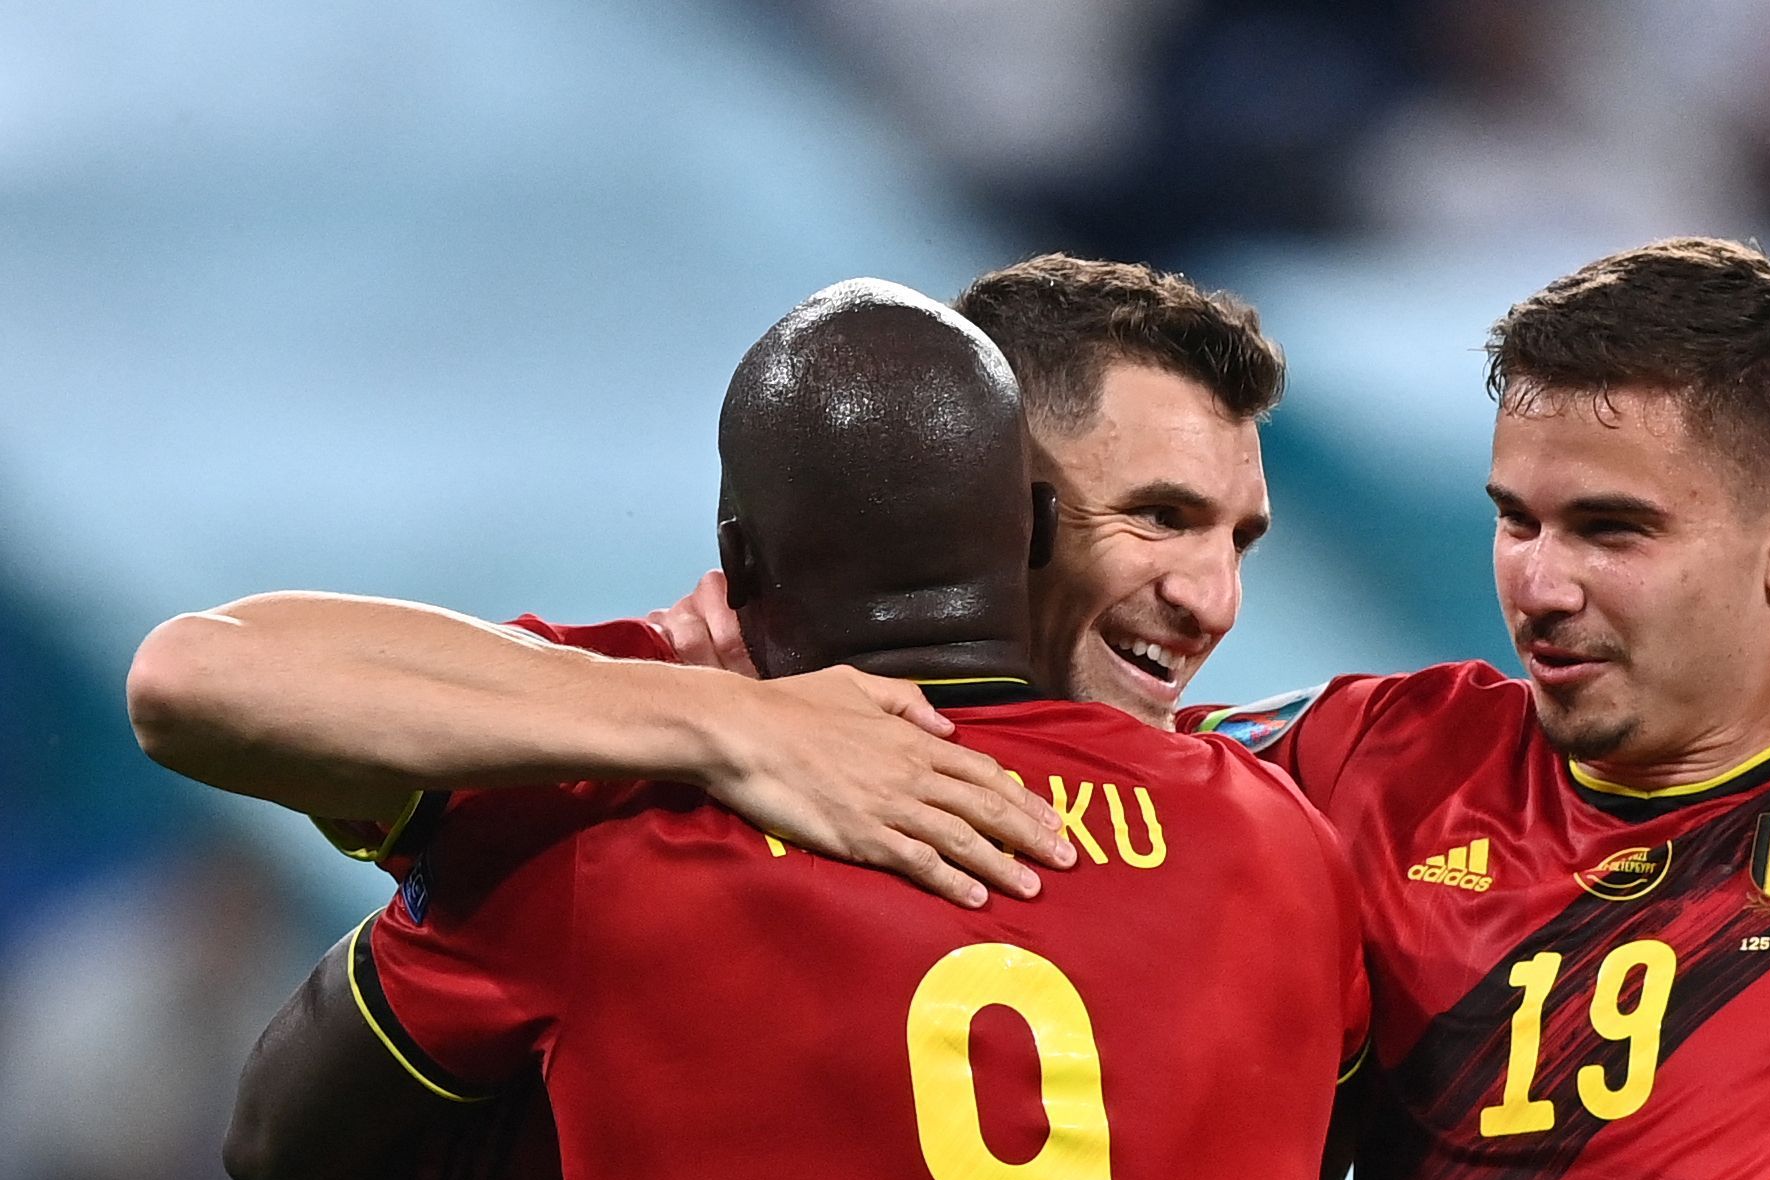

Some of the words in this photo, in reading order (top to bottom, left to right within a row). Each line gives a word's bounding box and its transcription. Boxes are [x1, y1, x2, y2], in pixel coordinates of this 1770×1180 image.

[1407, 864, 1493, 892] adidas
[1739, 936, 1770, 951] 125
[1480, 939, 1677, 1137] 19
